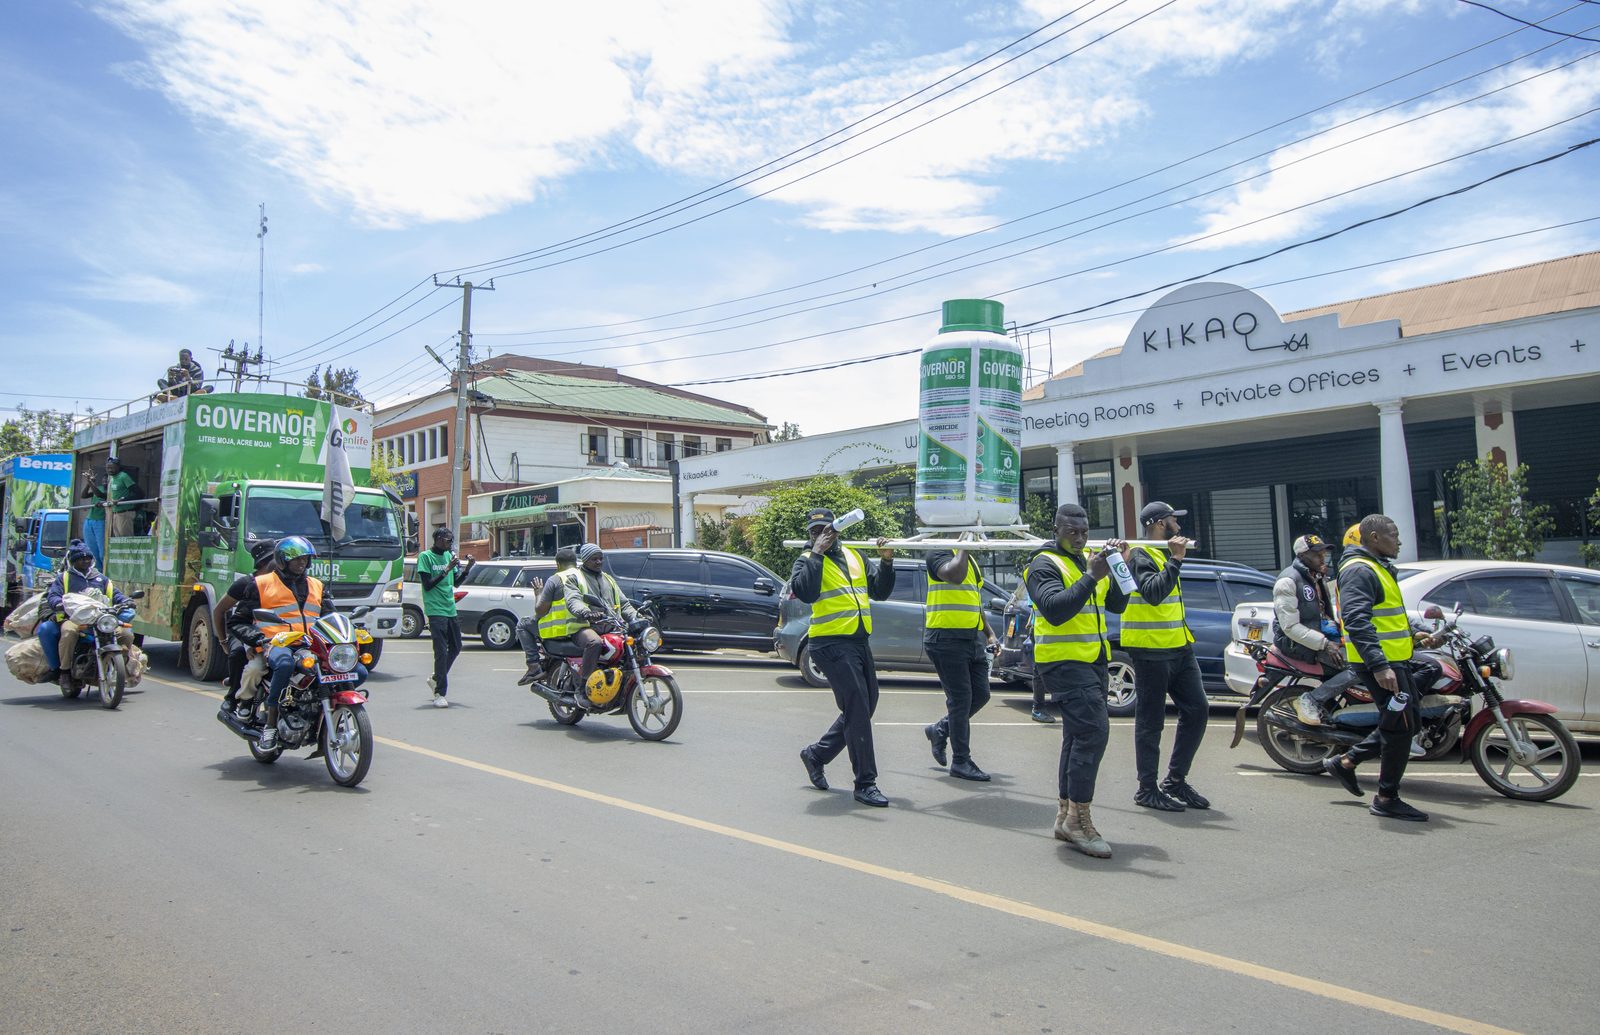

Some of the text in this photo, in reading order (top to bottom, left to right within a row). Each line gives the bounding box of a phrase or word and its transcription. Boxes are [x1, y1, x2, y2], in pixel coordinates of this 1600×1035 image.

[1143, 312, 1309, 352] KIKAO 64
[920, 361, 966, 378] OVERNOR
[1095, 402, 1154, 421] Rooms
[1201, 384, 1281, 407] Private
[1289, 368, 1380, 393] Offices
[1441, 345, 1542, 372] Events
[195, 404, 317, 437] GOVERNOR
[198, 435, 272, 448] LITRE MOJA, ACRE MOJA!
[279, 436, 316, 447] 580 SE
[343, 436, 369, 446] enlife
